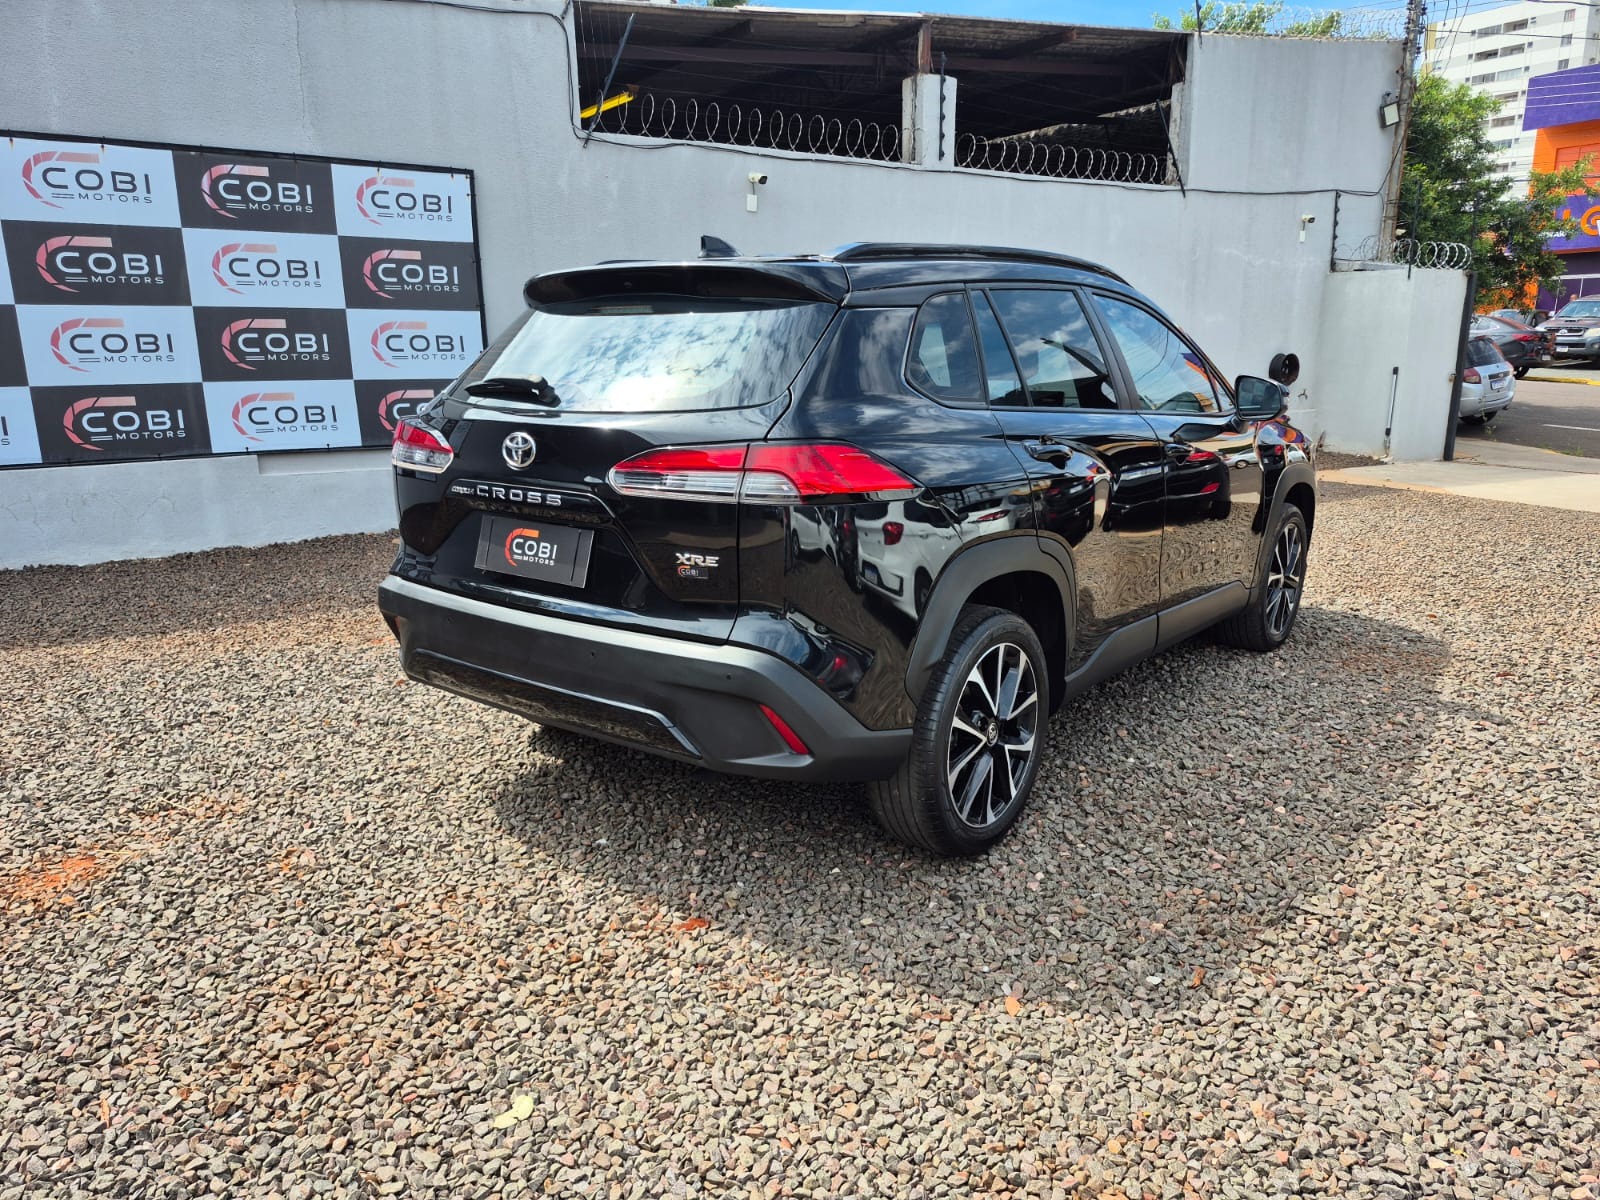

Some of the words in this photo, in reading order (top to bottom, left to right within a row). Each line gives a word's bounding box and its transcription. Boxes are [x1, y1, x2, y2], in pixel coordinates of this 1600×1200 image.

[41, 167, 152, 194] COBI
[78, 193, 153, 204] MOTORS
[218, 179, 313, 205] COBI
[249, 203, 314, 213] MOTORS
[370, 190, 453, 214] COBI
[397, 212, 453, 222] MOTORS
[55, 251, 163, 275] COBI
[228, 257, 321, 280] COBI
[91, 275, 164, 284] MOTORS
[377, 263, 458, 284] COBI
[259, 279, 322, 288] MOTORS
[404, 284, 460, 293] MOTORS
[69, 333, 174, 354] COBI
[237, 333, 329, 353] COBI
[385, 334, 465, 353] COBI
[104, 355, 175, 363] MOTORS
[267, 353, 330, 361] MOTORS
[411, 353, 466, 361] MOTORS
[81, 409, 185, 432] COBI
[247, 405, 337, 425] COBI
[116, 430, 186, 441] MOTORS
[277, 424, 339, 433] MOTORS
[476, 485, 562, 506] CROSS
[512, 538, 558, 560] COBI
[523, 555, 555, 566] MOTORS
[675, 552, 719, 567] XRE
